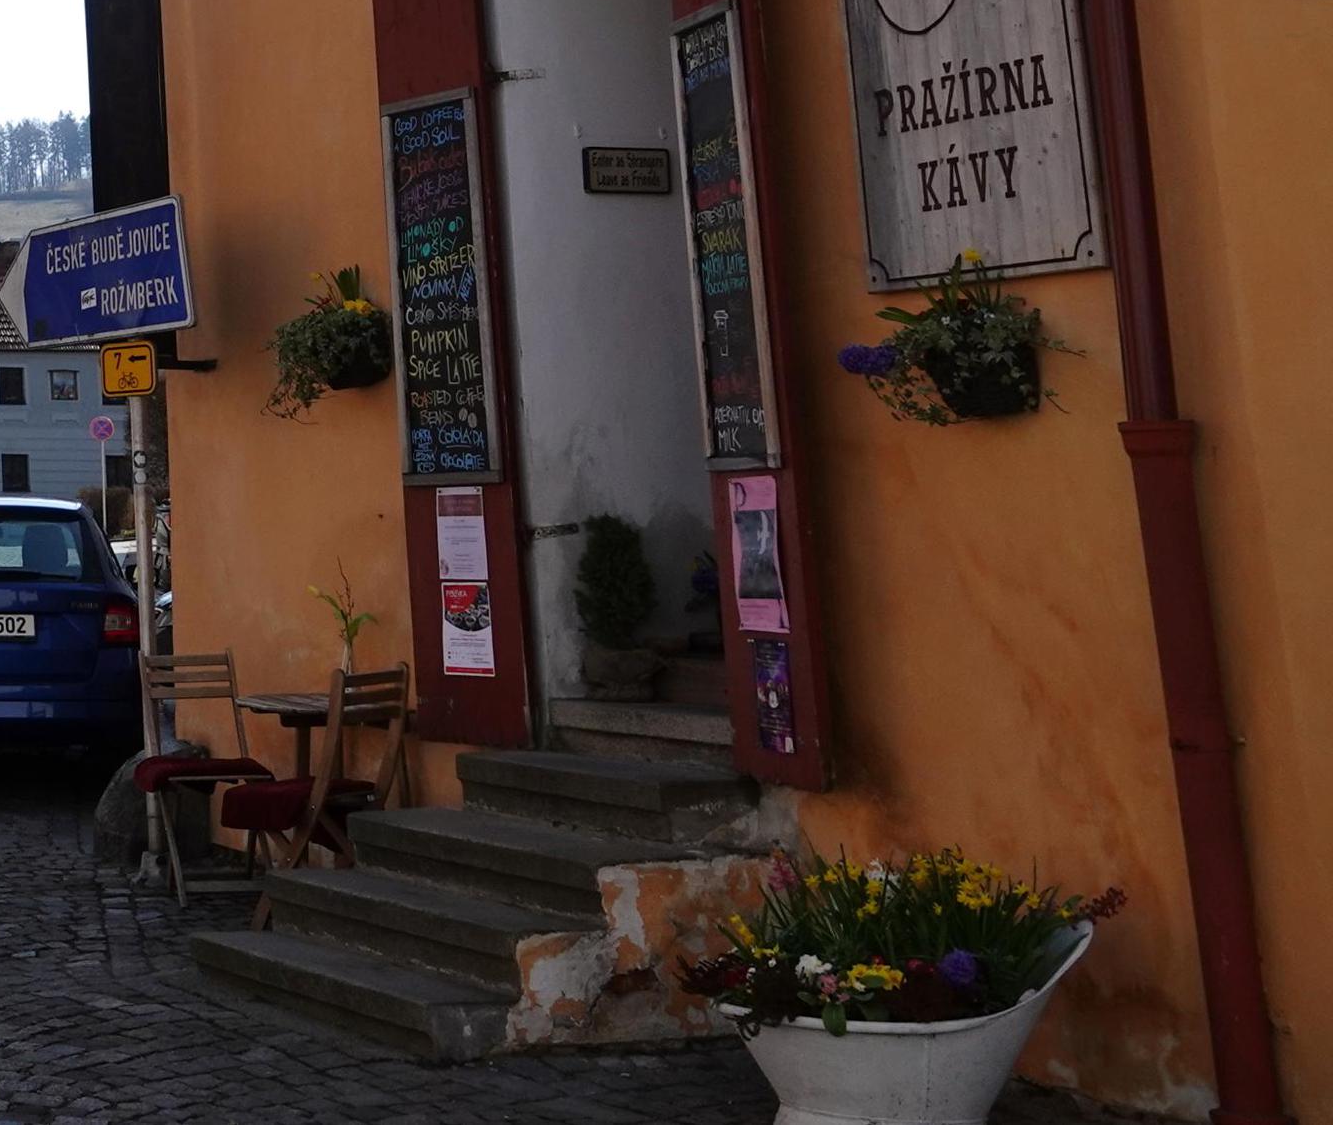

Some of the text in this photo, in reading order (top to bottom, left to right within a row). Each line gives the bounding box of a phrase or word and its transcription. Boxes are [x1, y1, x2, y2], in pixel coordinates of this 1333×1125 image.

[874, 54, 1054, 137] PRAŽÍRNA
[402, 130, 430, 155] GOOD
[432, 123, 461, 147] SOUL
[917, 143, 1018, 212] KÁVY
[46, 222, 172, 275] ČESKÉ BUDĚJOVICE
[100, 277, 179, 316] ROŽMBERK
[412, 322, 469, 356] PUMPKIN
[114, 352, 122, 370] 7
[408, 352, 482, 385] SPICE LATTE
[717, 427, 742, 452] MILK
